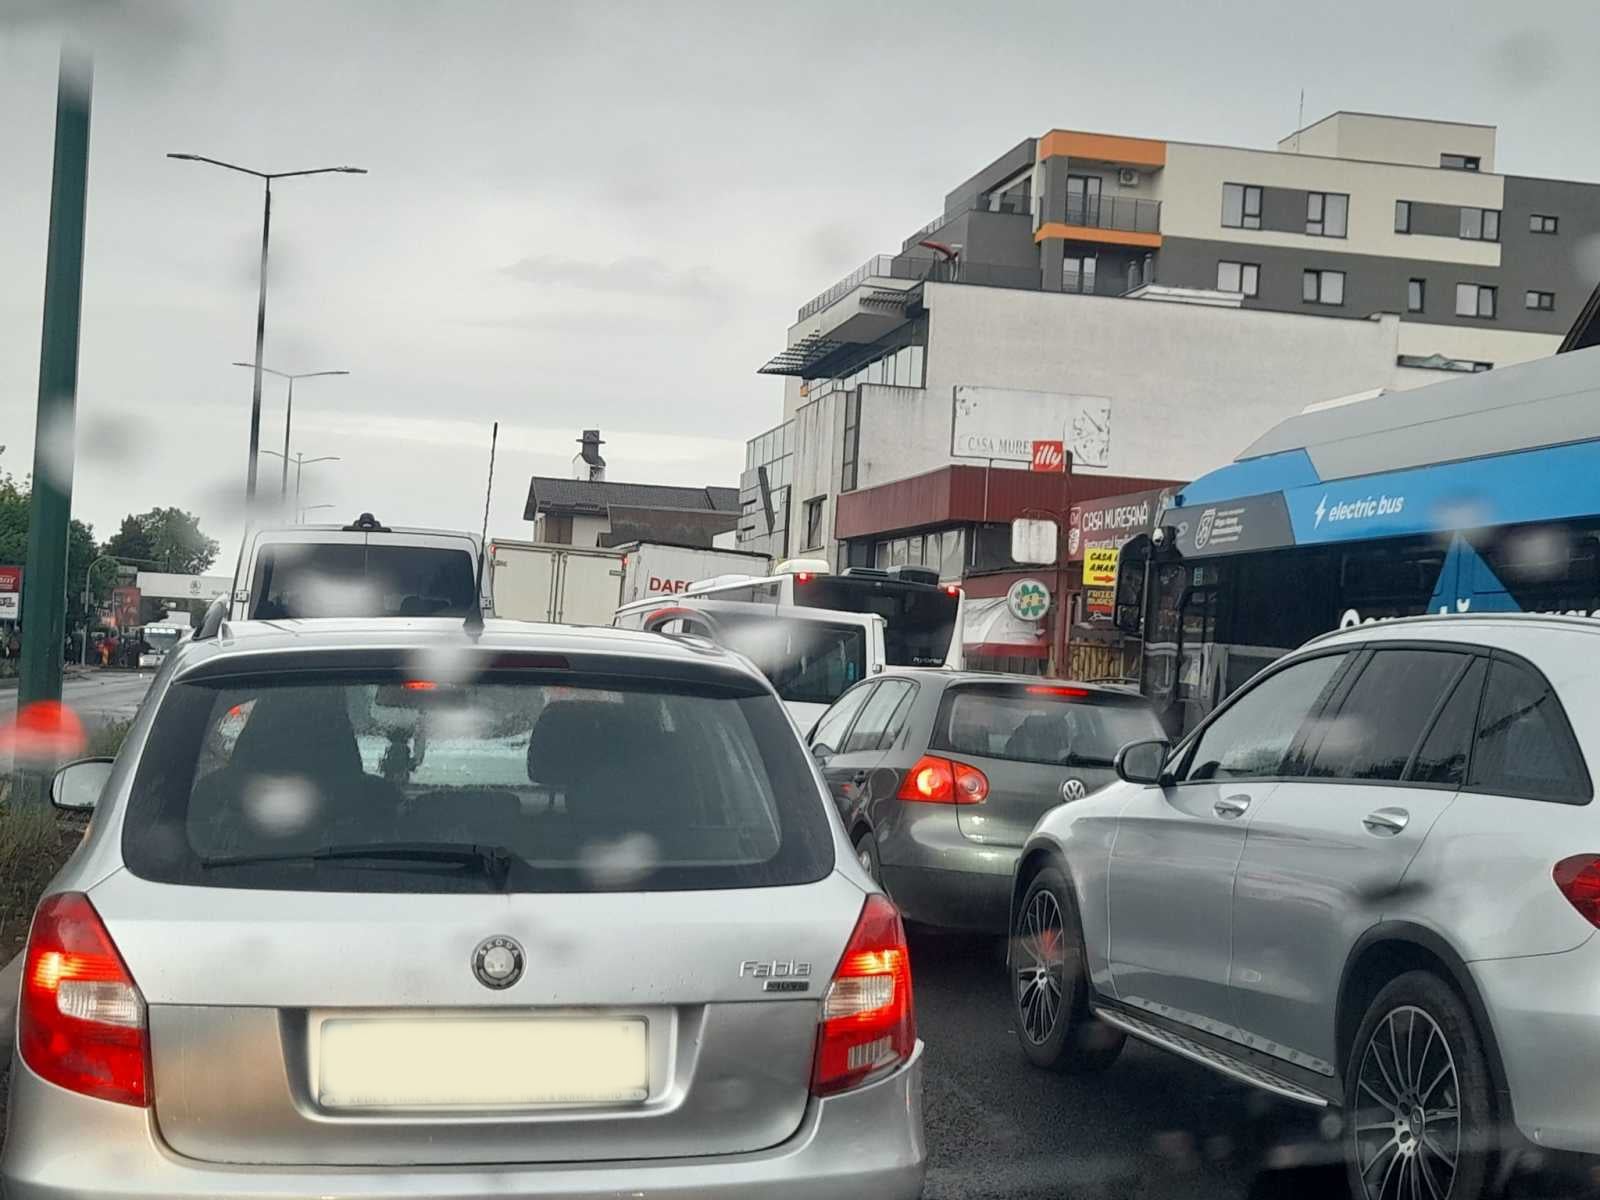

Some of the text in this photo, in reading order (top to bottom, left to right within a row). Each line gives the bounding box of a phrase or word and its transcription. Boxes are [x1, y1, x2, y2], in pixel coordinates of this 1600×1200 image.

[1000, 438, 1031, 456] MURE
[1035, 444, 1061, 470] illy
[1328, 496, 1404, 522] electric bus
[1082, 510, 1104, 532] CASA
[1090, 553, 1112, 561] CASA
[1089, 564, 1116, 573] AMAN
[739, 959, 812, 977] Fabia
